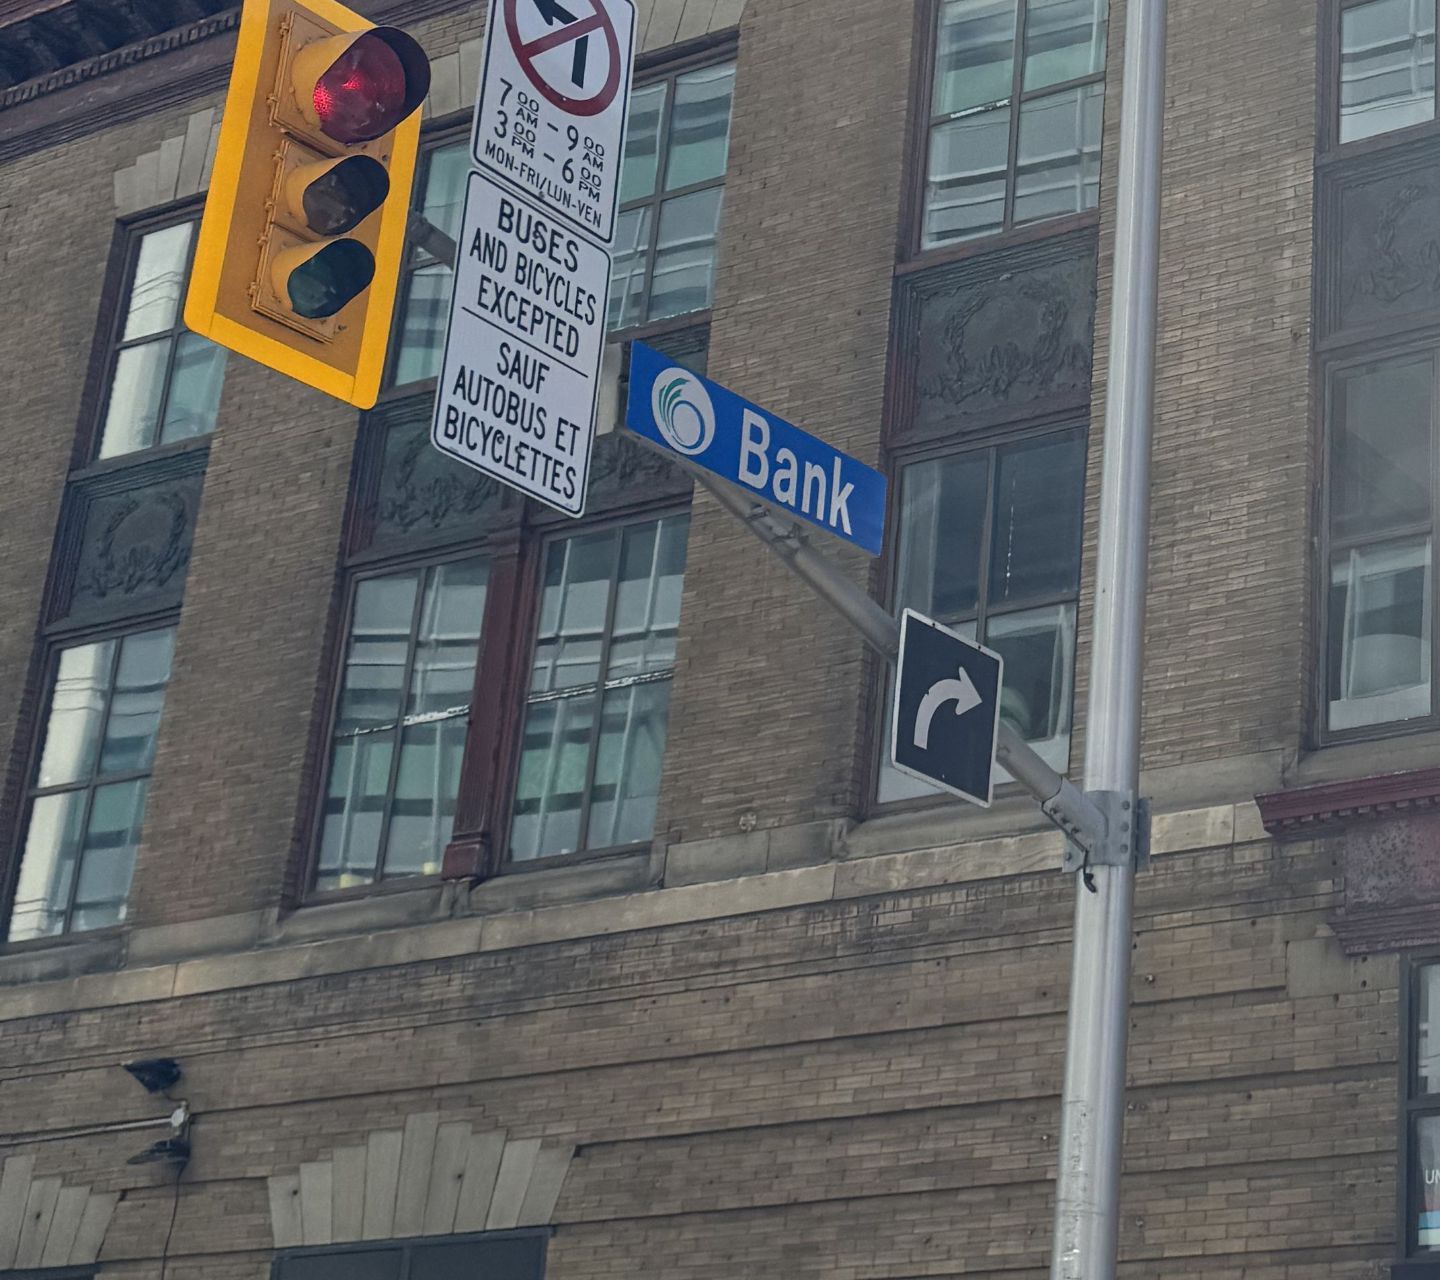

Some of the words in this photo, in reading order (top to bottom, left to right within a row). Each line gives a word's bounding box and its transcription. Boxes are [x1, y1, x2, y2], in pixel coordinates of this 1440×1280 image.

[494, 110, 508, 139] 3
[562, 158, 574, 184] 6
[500, 78, 513, 106] 7
[566, 125, 579, 151] 9
[470, 227, 507, 273] AND
[515, 252, 597, 325] BICYCLES
[498, 198, 579, 272] BUSES
[477, 274, 580, 358] EXCEPTED
[497, 342, 550, 394] SAUF
[444, 404, 577, 499] BICYCLETTES
[453, 365, 547, 440] AUTOBUS
[555, 417, 581, 456] ET
[738, 408, 854, 536] Bank
